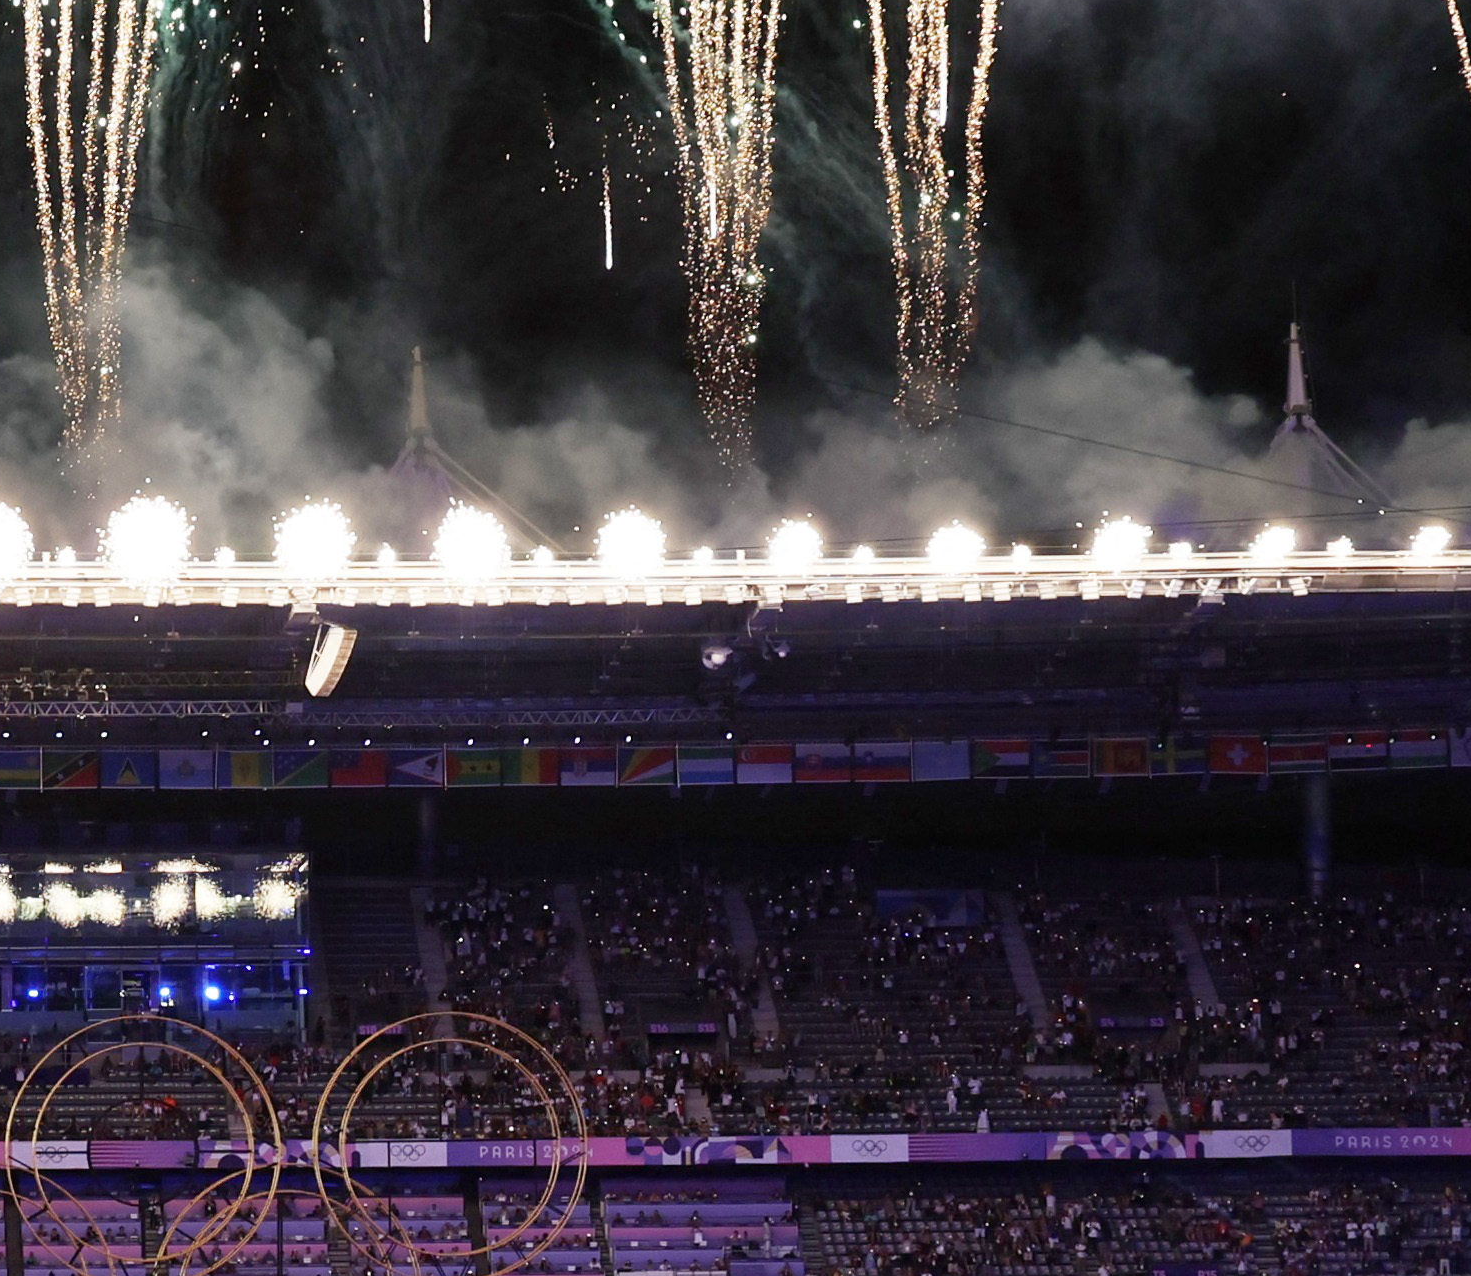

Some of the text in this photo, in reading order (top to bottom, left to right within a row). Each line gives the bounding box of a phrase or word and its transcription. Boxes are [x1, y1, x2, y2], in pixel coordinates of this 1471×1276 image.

[1150, 1018, 1164, 1027] S3
[650, 1024, 668, 1033] S16
[698, 1024, 715, 1033] S15
[1335, 1135, 1452, 1149] PARIS 2024
[479, 1146, 535, 1159] PARIS
